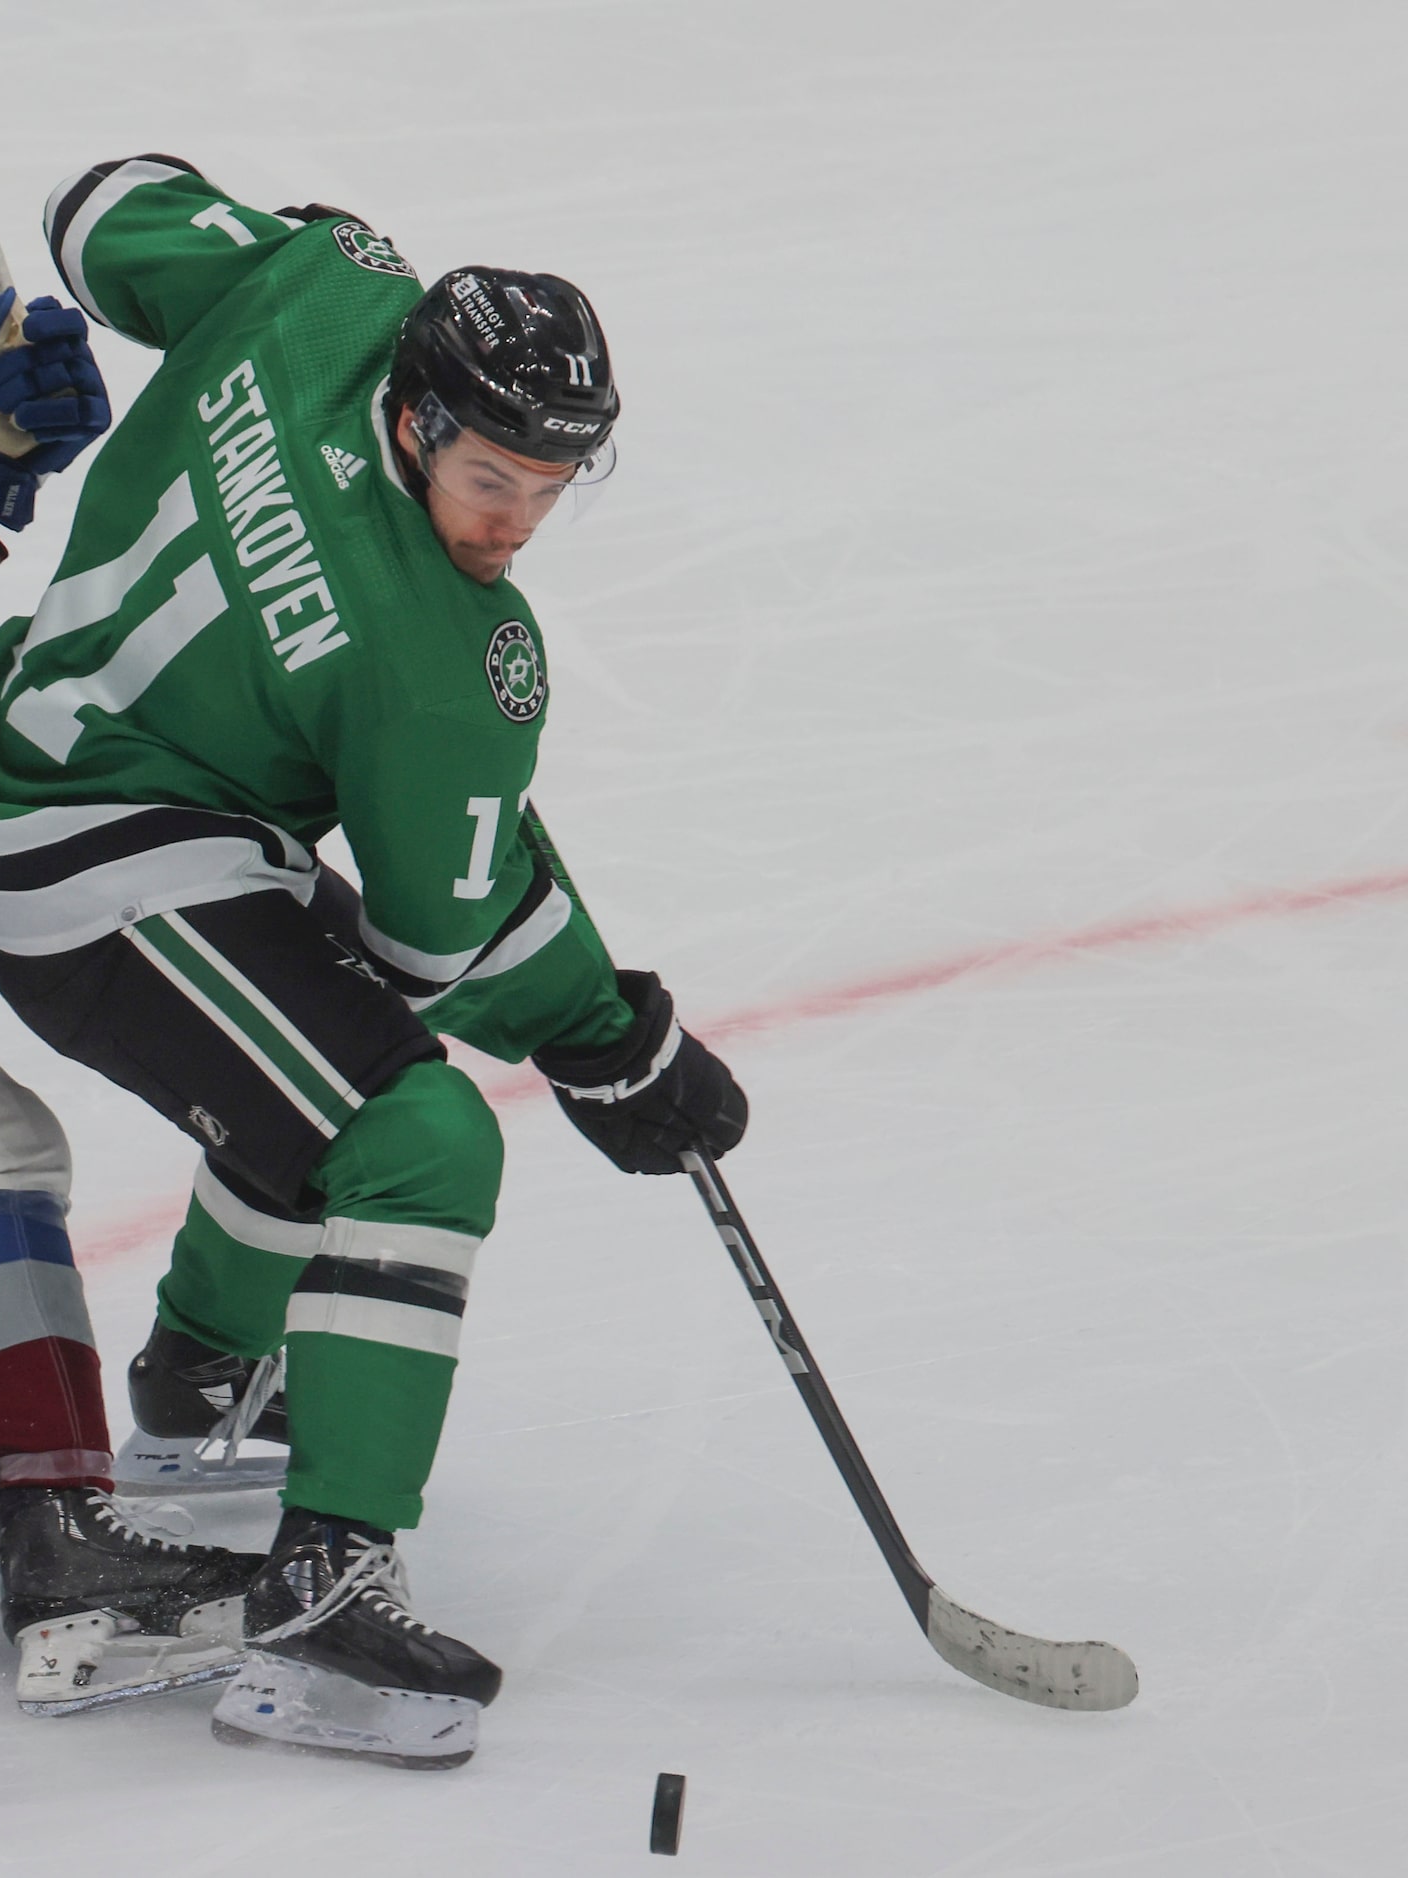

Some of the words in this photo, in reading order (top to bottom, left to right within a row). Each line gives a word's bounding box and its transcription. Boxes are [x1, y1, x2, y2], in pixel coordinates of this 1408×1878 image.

[461, 297, 500, 349] TRANSFER
[472, 289, 505, 329] ENERGY
[565, 353, 593, 387] 11
[543, 417, 601, 434] CCM
[321, 444, 349, 490] adidas
[197, 360, 351, 673] STANKOVEN
[0, 470, 230, 766] 11
[499, 685, 544, 714] STARS
[453, 790, 530, 900] 1
